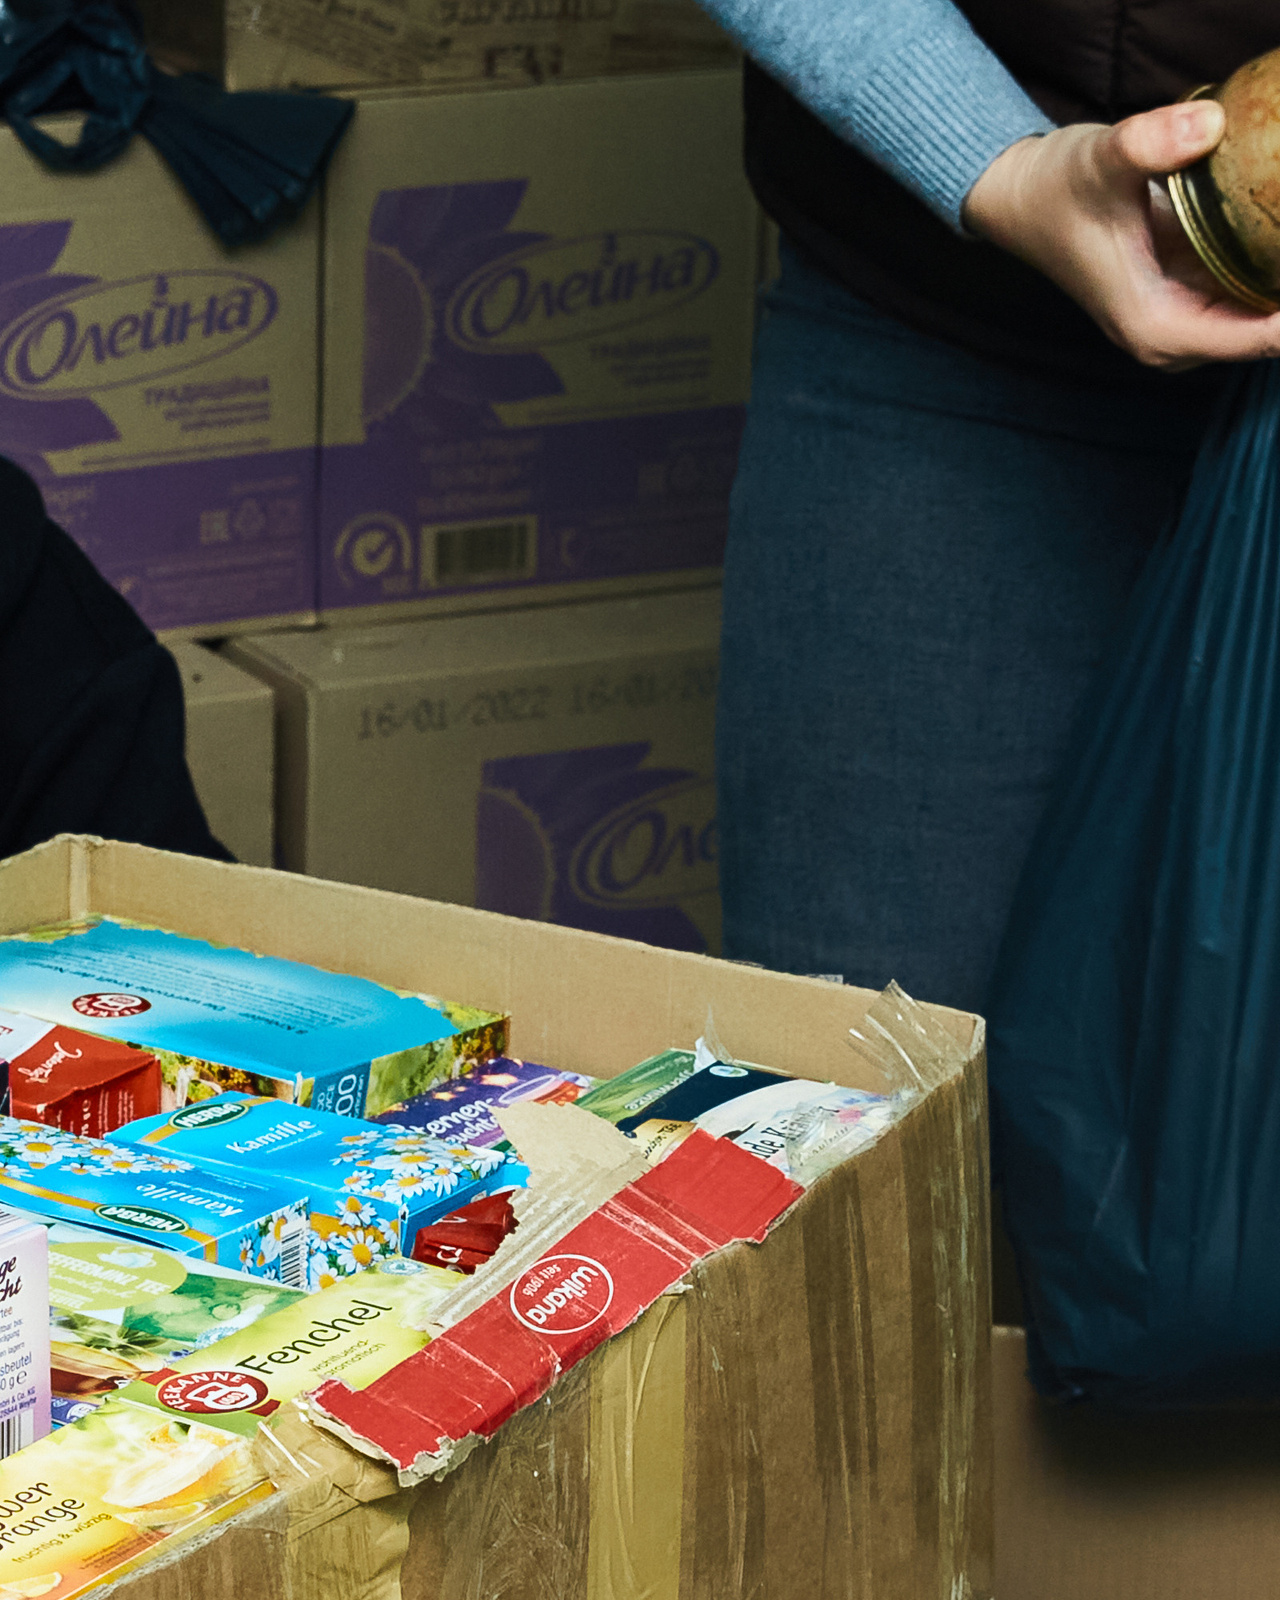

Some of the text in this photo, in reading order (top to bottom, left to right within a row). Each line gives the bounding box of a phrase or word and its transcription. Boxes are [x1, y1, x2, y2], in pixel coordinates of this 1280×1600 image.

[471, 233, 697, 338] Олейна
[16, 274, 258, 385] Олейна
[181, 1102, 242, 1128] HERBA
[226, 1118, 318, 1156] Kamille
[98, 1206, 187, 1232] HERBA
[136, 1183, 245, 1218] Kamille
[522, 1263, 562, 1299] seit 1906
[236, 1299, 394, 1378] Fenchel
[309, 1338, 370, 1374] wohltuend-
[322, 1342, 387, 1380] aromatisch
[28, 1386, 37, 1399] KG
[161, 1371, 247, 1413] TEEKANNE
[11, 1537, 60, 1566] fruchtig
[60, 1529, 73, 1542] &
[73, 1511, 113, 1539] würzig
